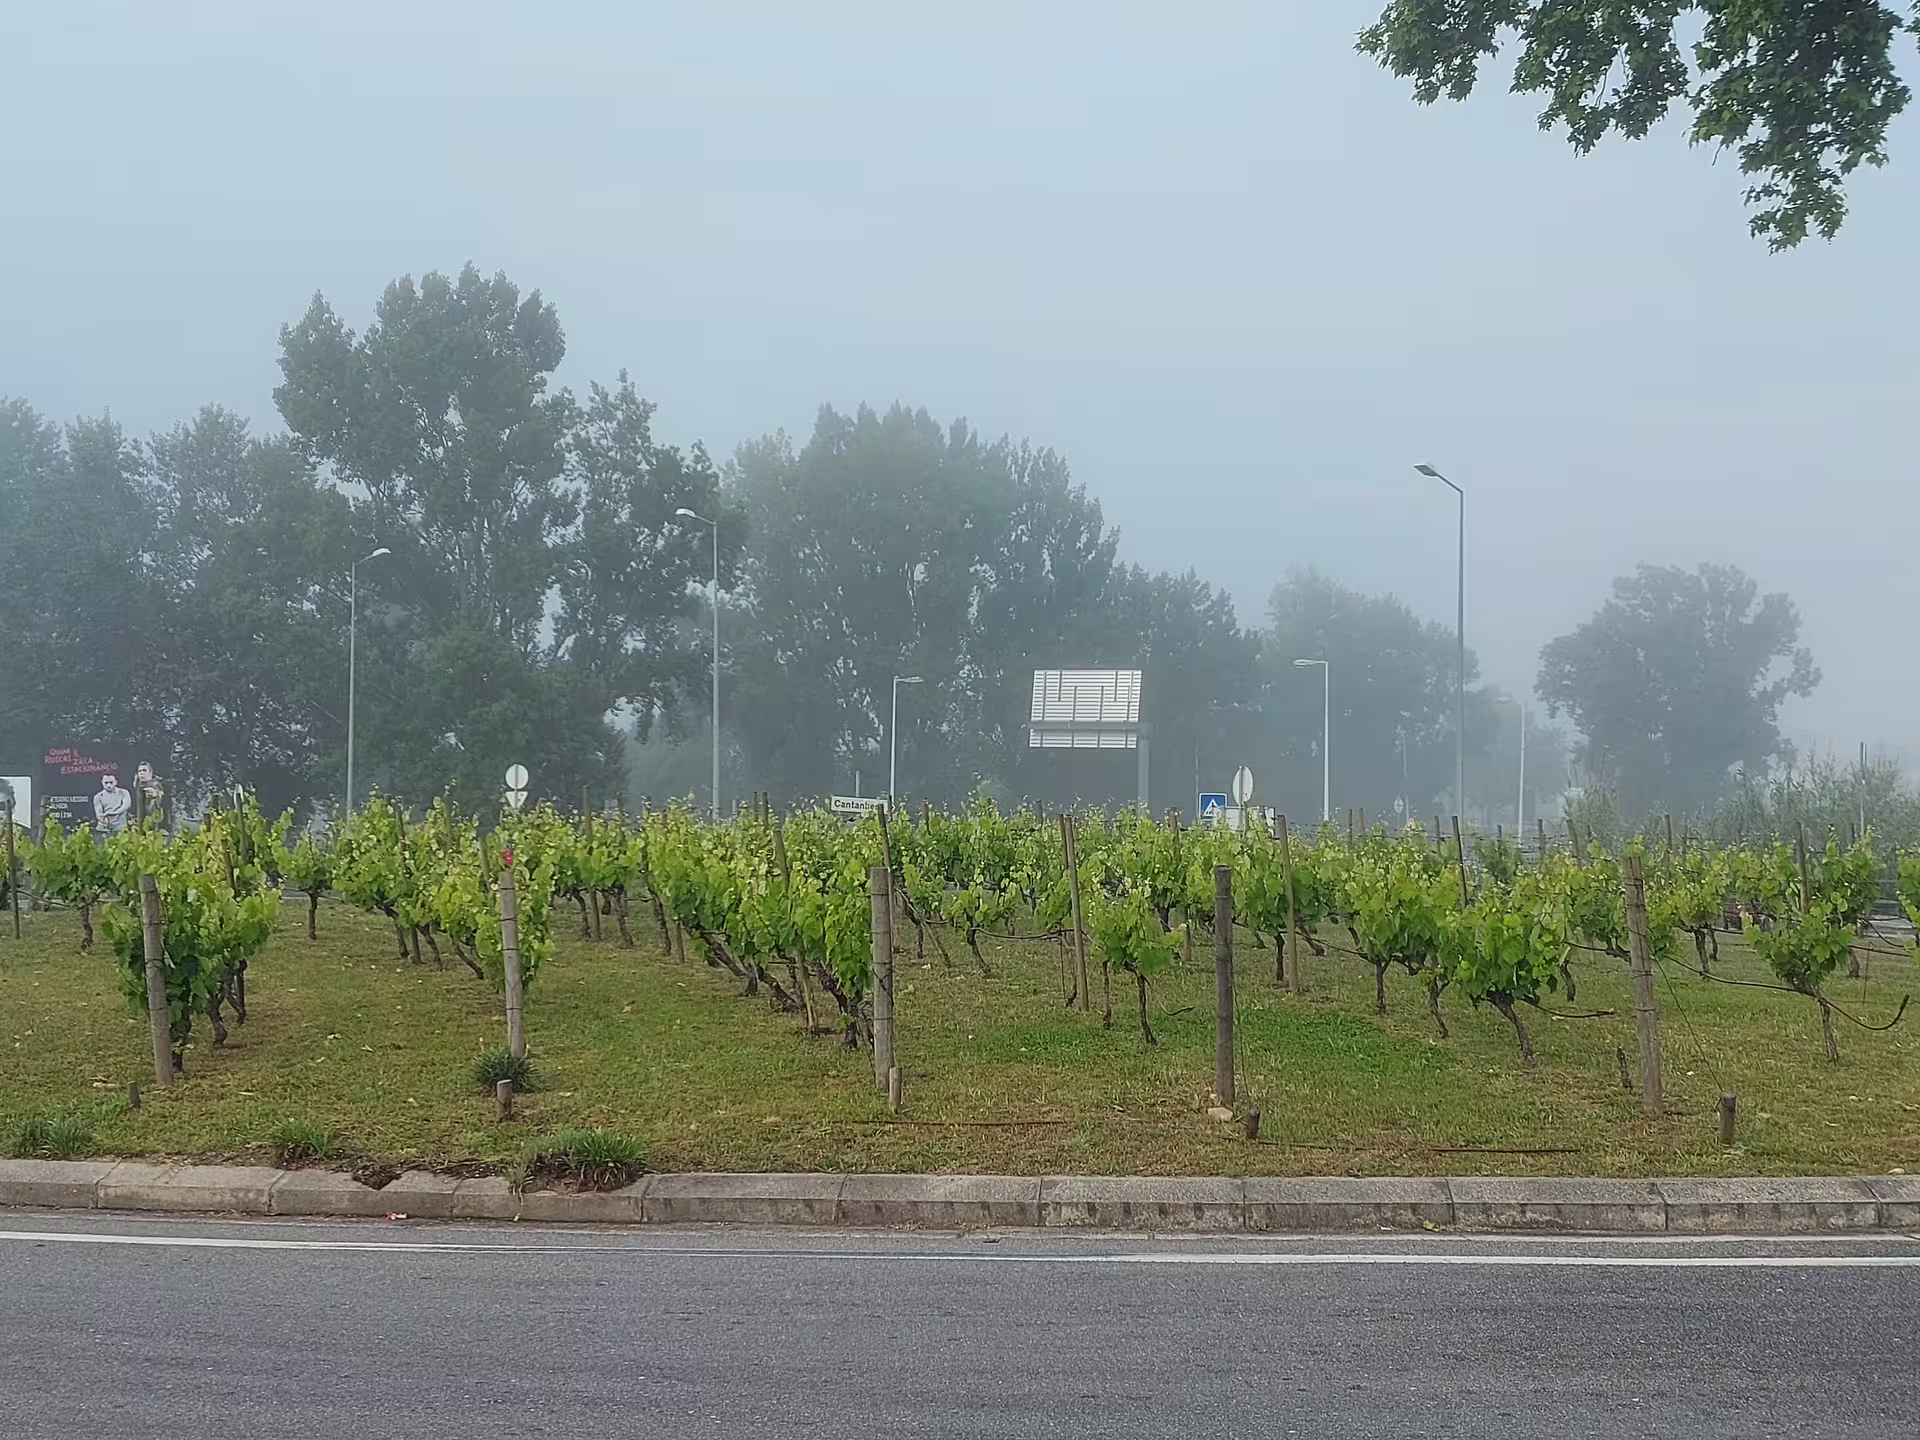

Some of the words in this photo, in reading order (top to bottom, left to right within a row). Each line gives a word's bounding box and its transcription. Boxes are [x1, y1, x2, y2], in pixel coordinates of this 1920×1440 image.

[45, 755, 72, 764] ROSCAS
[73, 757, 93, 765] ZECA
[834, 799, 879, 811] Cantanhe
